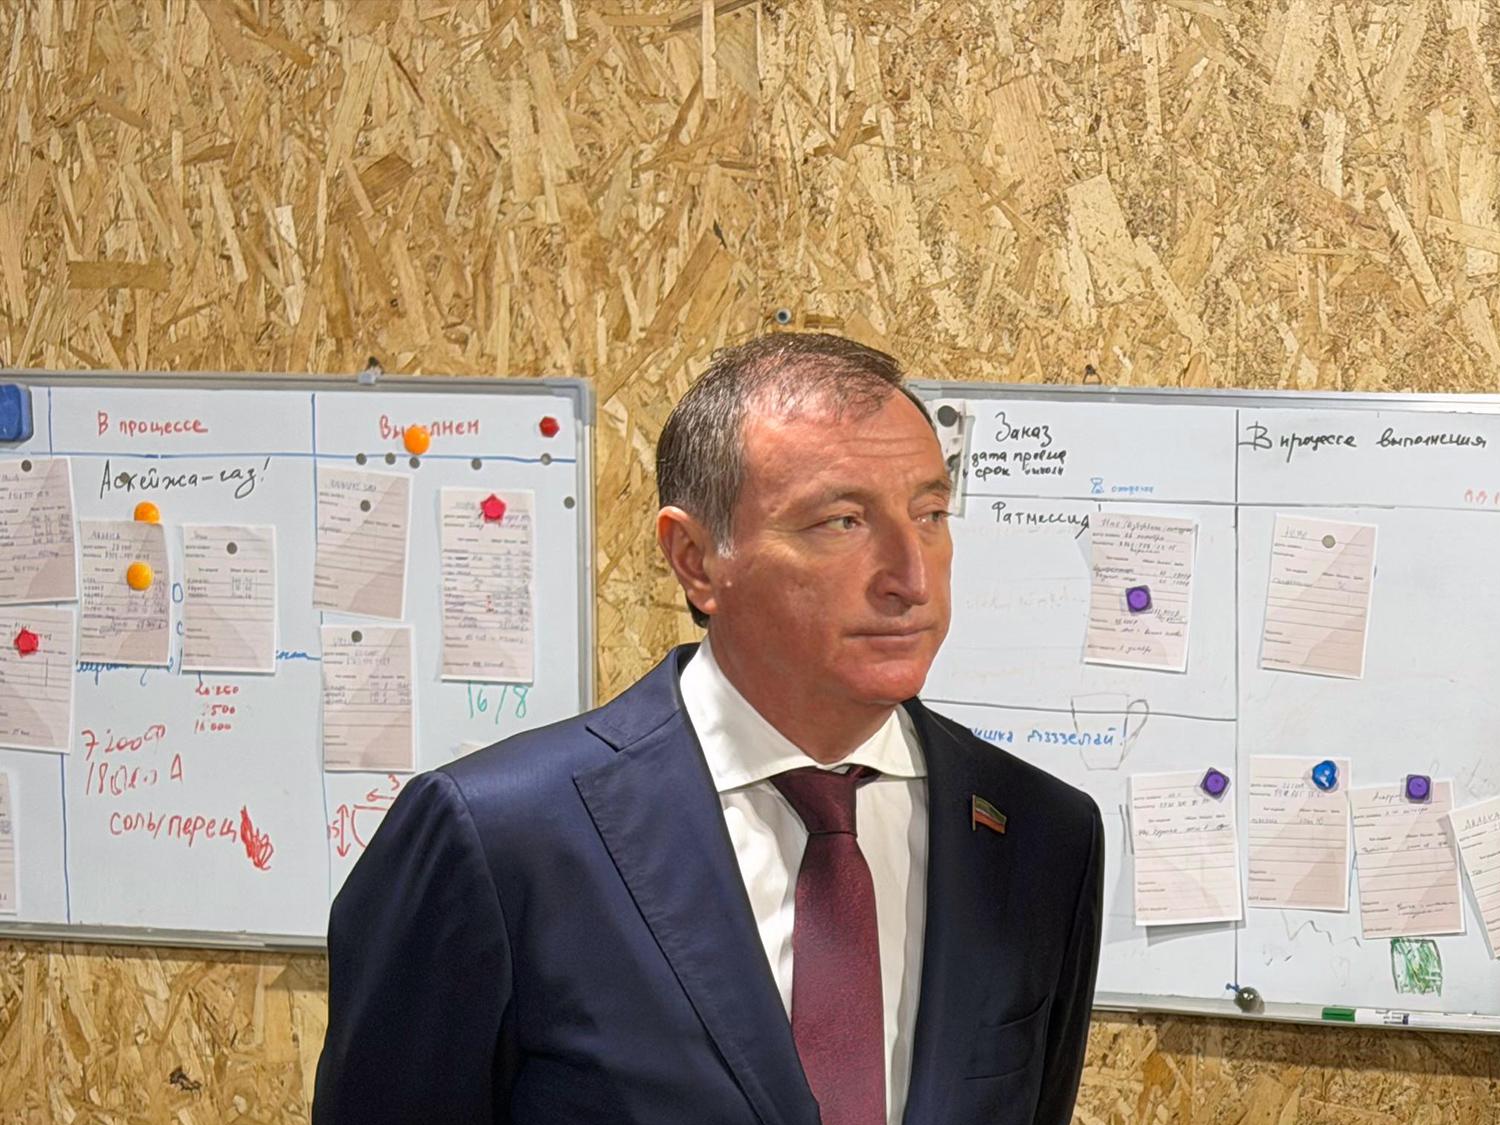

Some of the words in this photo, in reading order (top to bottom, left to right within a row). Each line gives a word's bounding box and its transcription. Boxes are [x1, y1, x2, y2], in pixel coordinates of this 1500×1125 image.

[97, 411, 109, 436] В
[119, 418, 209, 437] процессе
[994, 411, 1053, 447] Заказ
